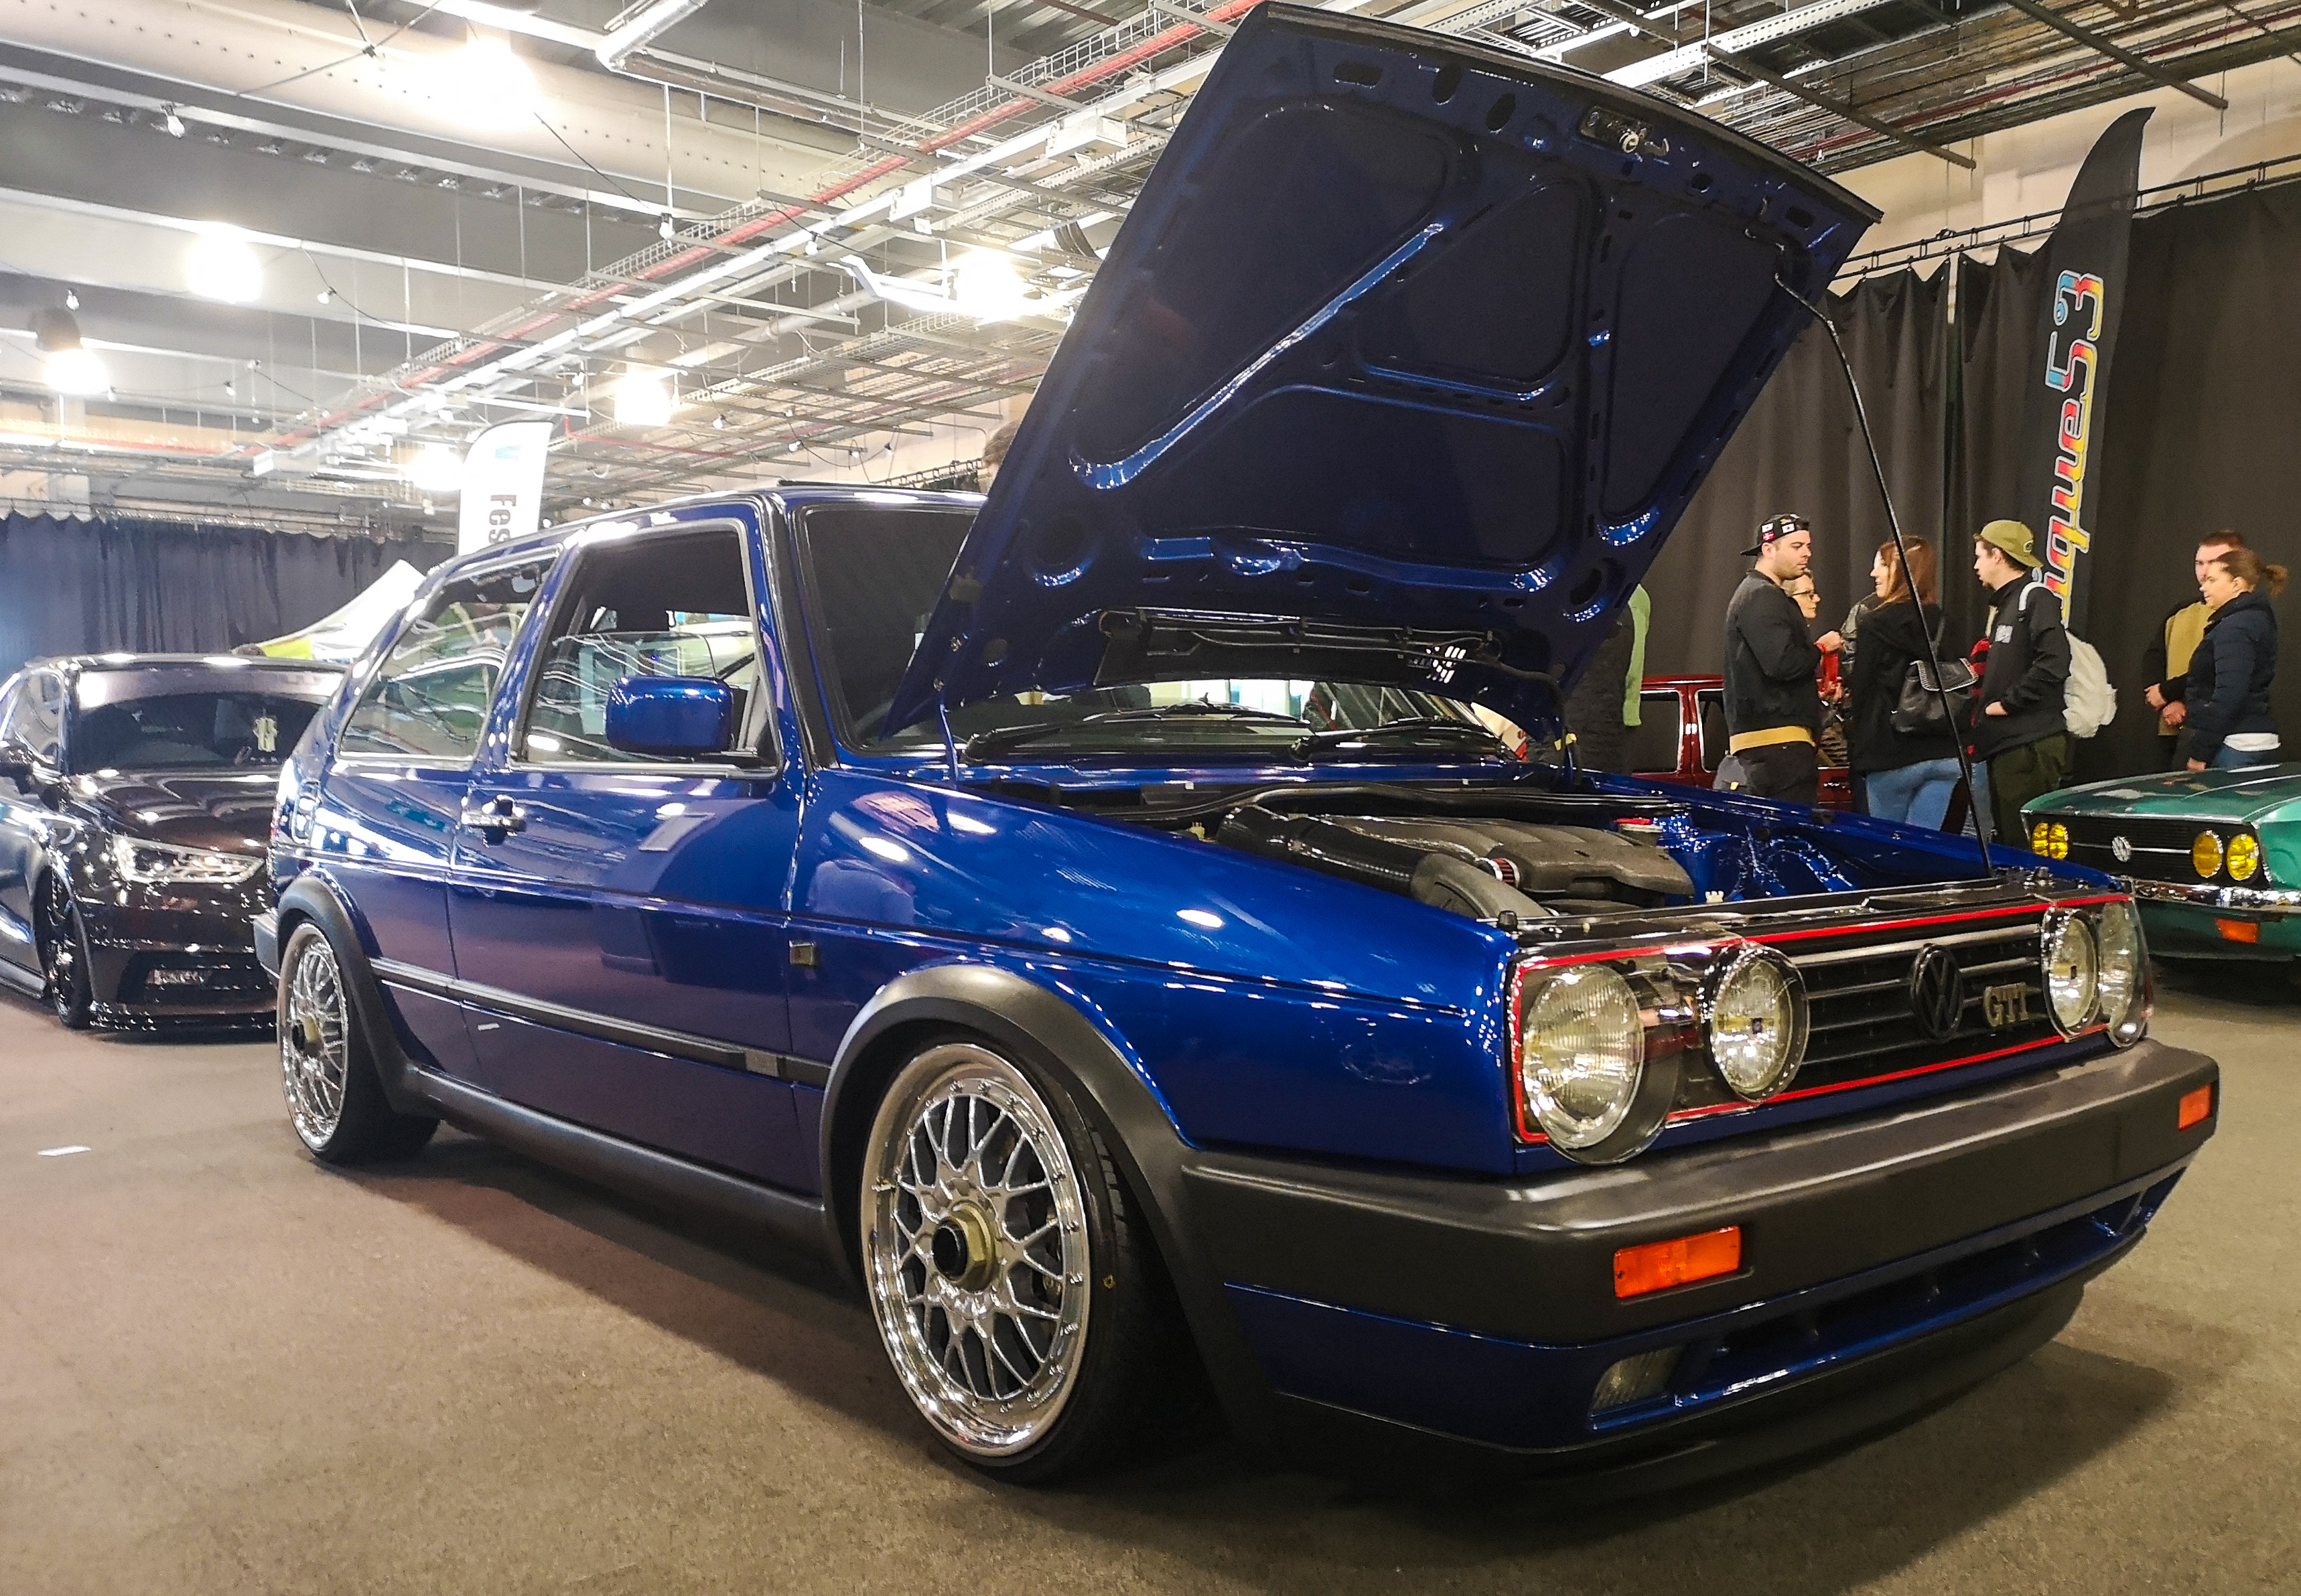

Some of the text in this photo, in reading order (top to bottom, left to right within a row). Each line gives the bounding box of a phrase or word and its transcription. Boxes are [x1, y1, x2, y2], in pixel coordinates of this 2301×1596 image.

[2032, 269, 2104, 629] ique53
[488, 494, 518, 545] Fes
[1985, 981, 2029, 1027] GTI
